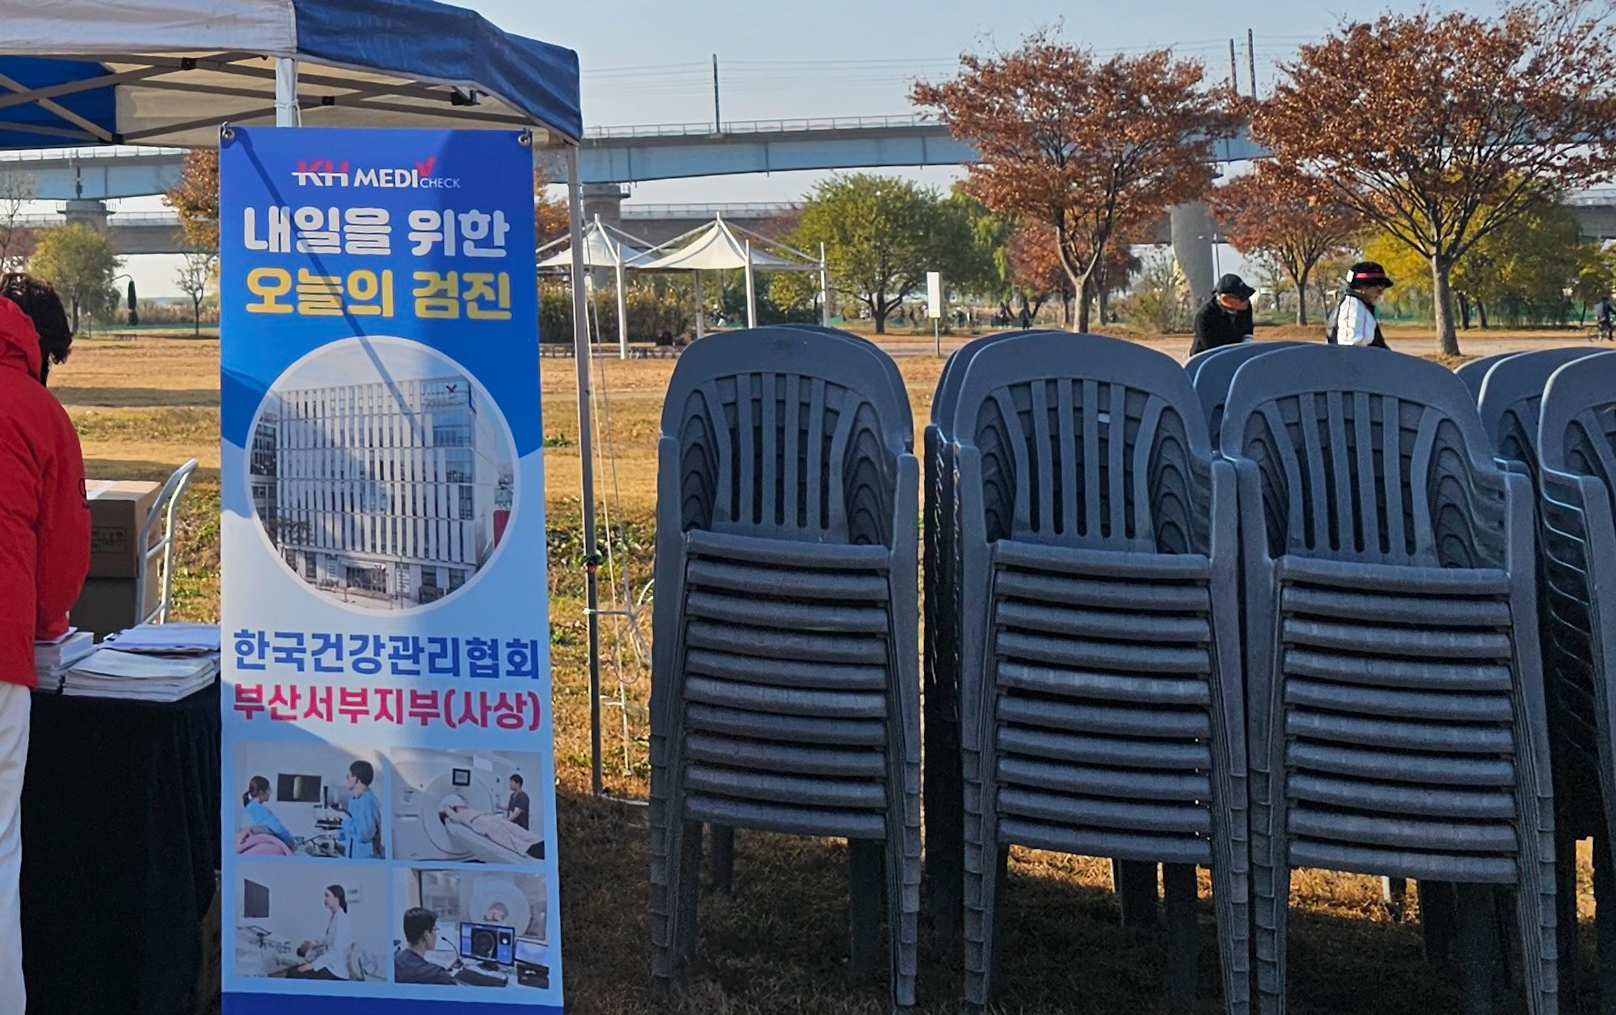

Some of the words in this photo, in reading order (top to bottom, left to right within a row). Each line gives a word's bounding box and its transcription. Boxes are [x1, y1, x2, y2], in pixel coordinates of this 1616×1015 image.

[243, 205, 392, 257] 내일을
[408, 208, 511, 259] 위한
[245, 266, 394, 318] 오늘의
[412, 270, 513, 321] 검진
[233, 628, 540, 680] 한국건강관리협회
[233, 683, 542, 732] 부산서부지부(사상)
